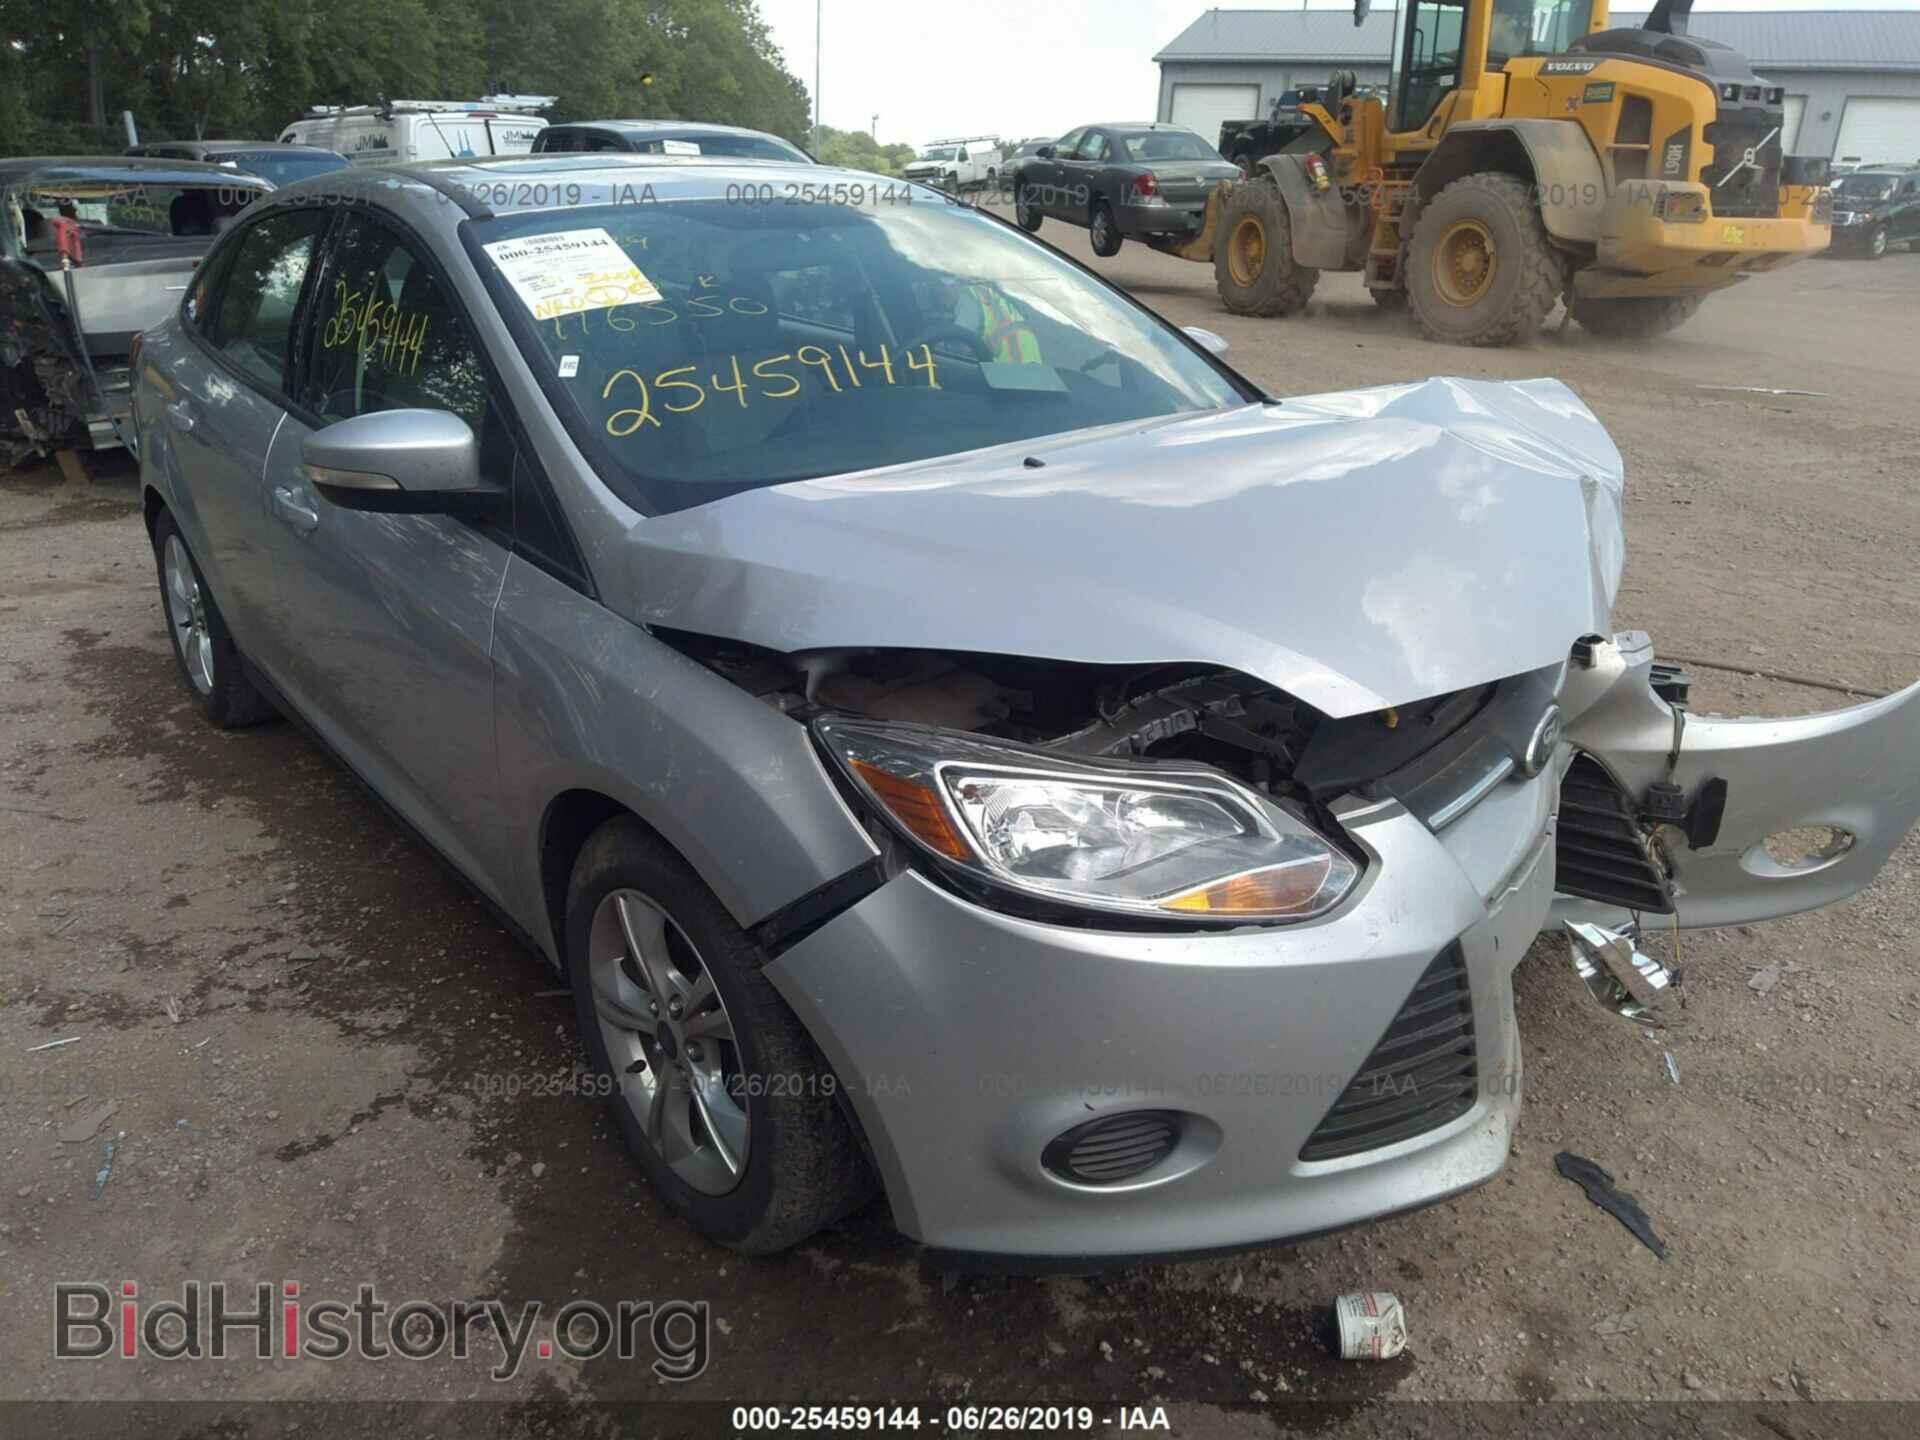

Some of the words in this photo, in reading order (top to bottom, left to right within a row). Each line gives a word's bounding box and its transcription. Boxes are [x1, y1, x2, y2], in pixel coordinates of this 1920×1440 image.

[1547, 62, 1595, 71] VOLVO
[1664, 144, 1684, 175] L90H
[602, 343, 942, 437] 25459144
